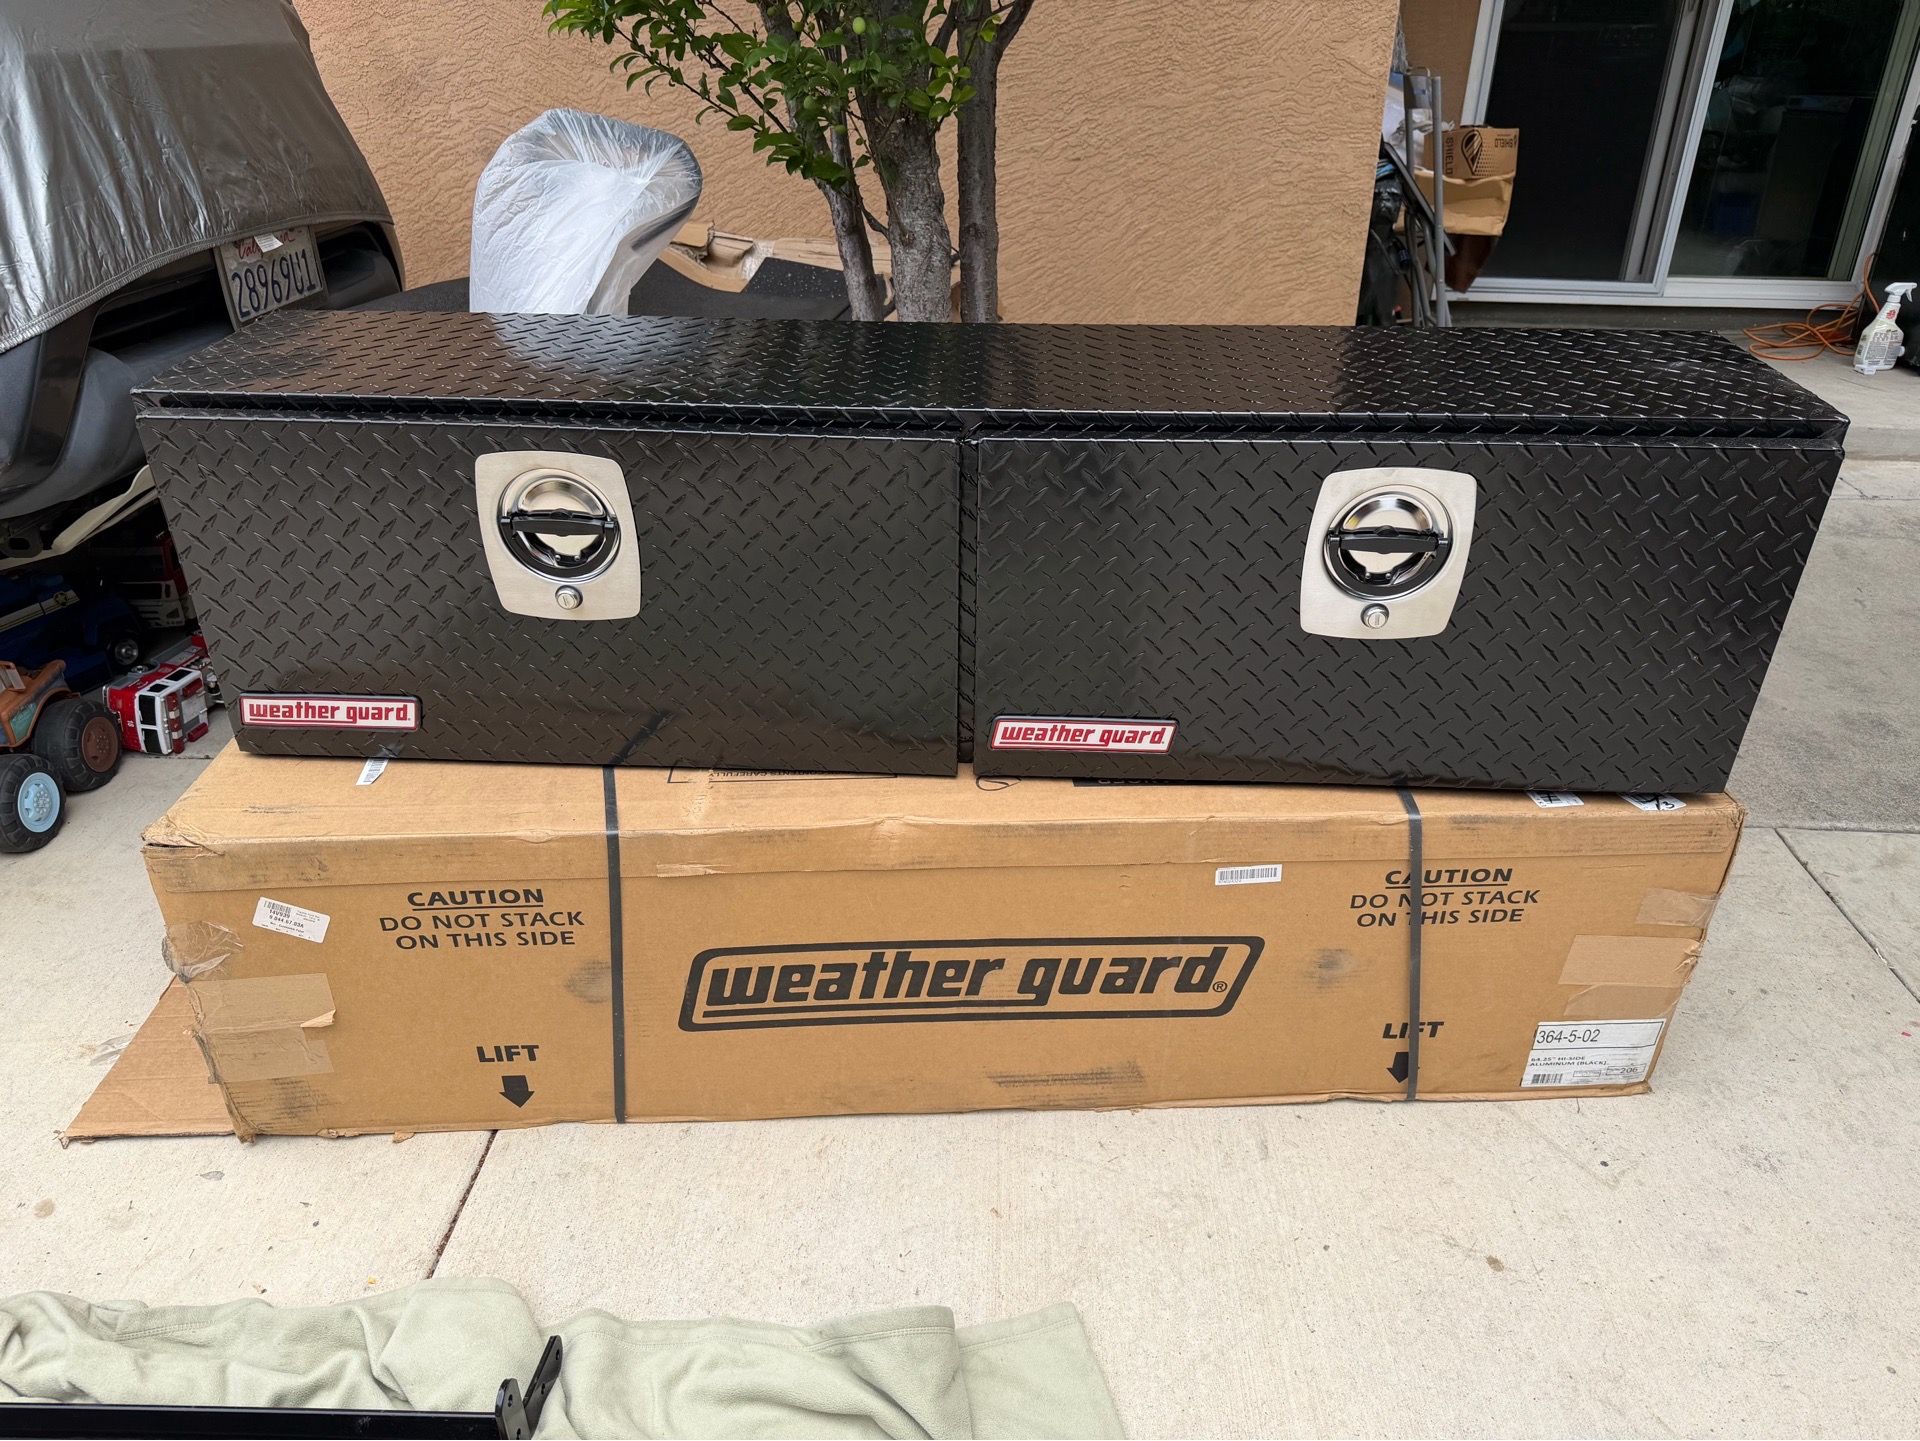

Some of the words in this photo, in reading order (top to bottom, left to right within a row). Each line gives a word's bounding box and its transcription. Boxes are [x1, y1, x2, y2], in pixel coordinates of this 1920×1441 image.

[1445, 137, 1454, 175] SHIELD
[231, 249, 316, 318] 28969U1
[249, 702, 340, 719] weather
[346, 704, 409, 724] guard
[1000, 725, 1095, 742] weather
[1099, 728, 1166, 746] guard
[407, 889, 544, 907] CAUTION
[1350, 894, 1388, 909] DO
[1461, 890, 1541, 905] STACK
[379, 916, 422, 931] DO
[432, 913, 490, 929] NOT
[501, 911, 585, 927] STACK
[1356, 912, 1397, 927] ON
[1406, 910, 1460, 926] HIS
[1468, 908, 1525, 923] SIDE
[396, 934, 439, 950] ON
[446, 932, 507, 948] THIS
[516, 931, 576, 946] SIDE
[705, 951, 1006, 1006] weather
[1017, 947, 1228, 1006] guard
[1536, 1029, 1601, 1044] 364-5-02
[476, 1044, 539, 1063] LIFT
